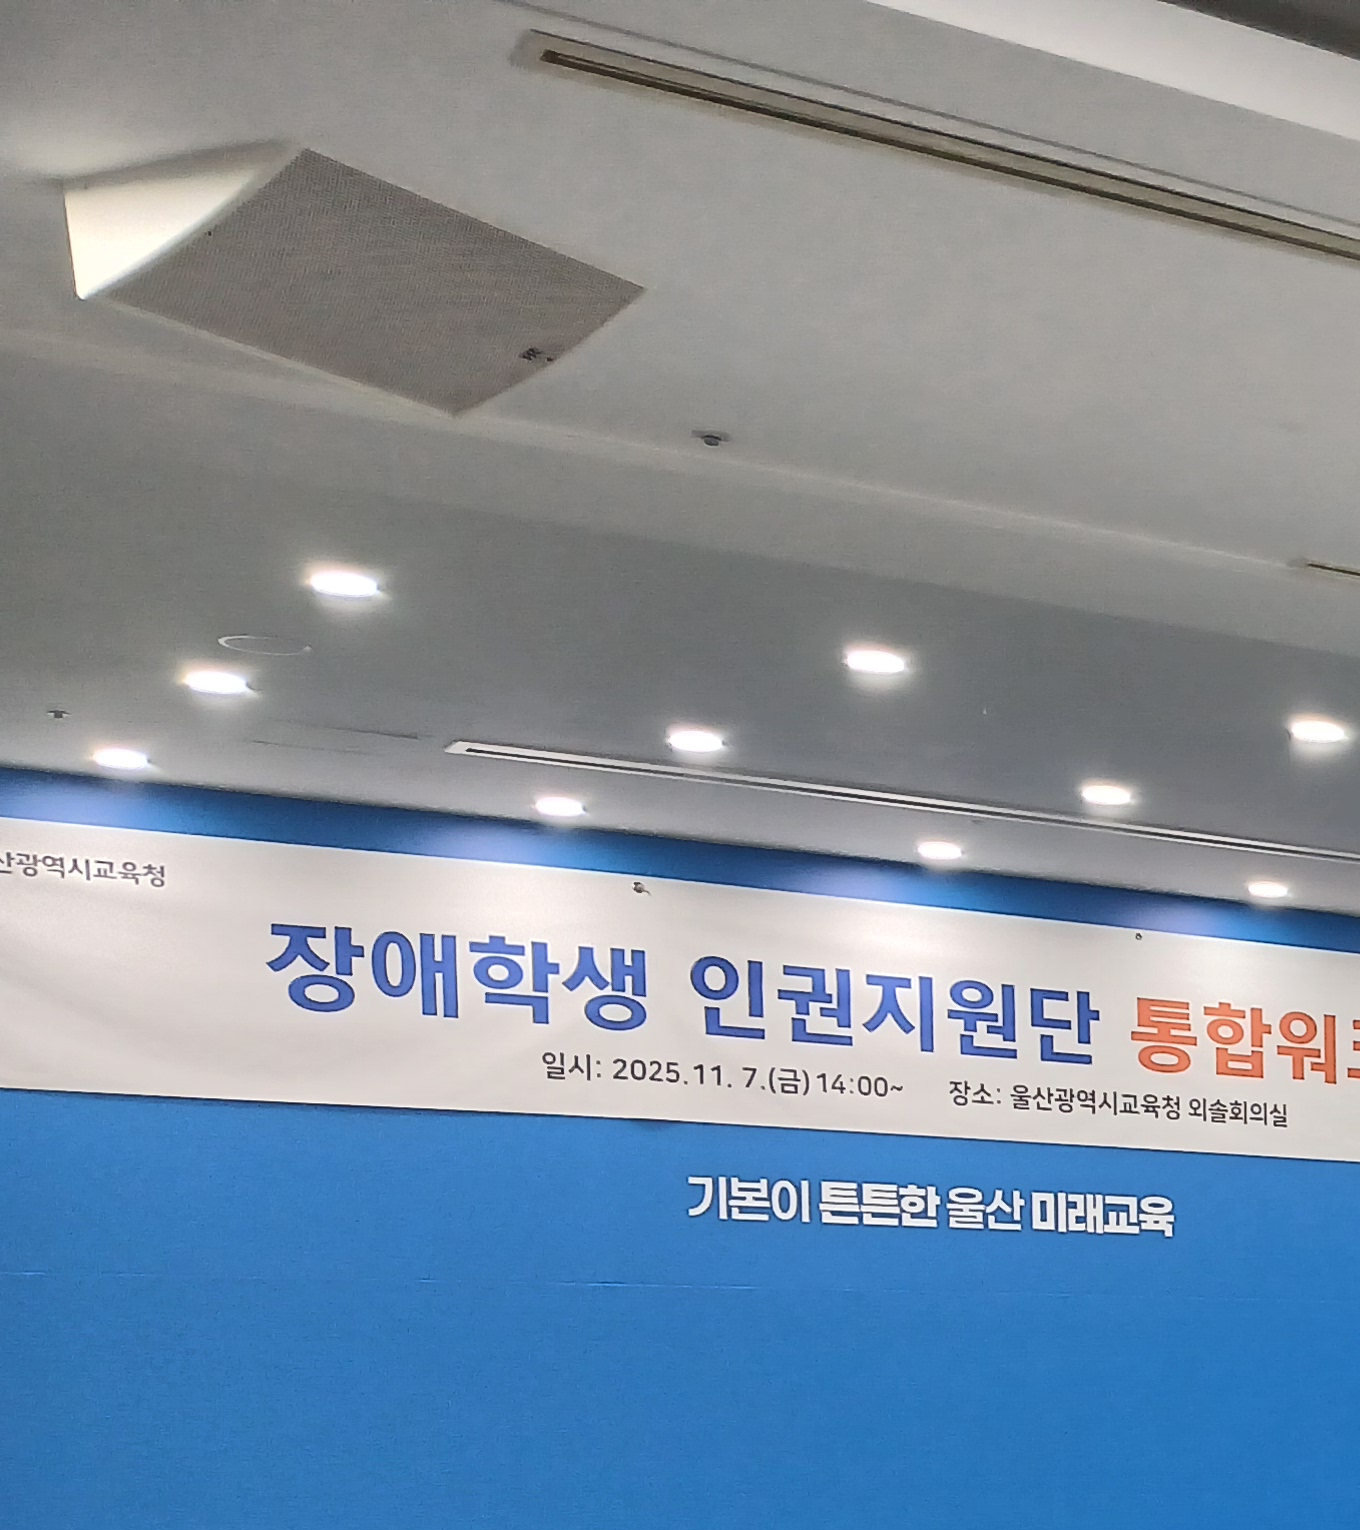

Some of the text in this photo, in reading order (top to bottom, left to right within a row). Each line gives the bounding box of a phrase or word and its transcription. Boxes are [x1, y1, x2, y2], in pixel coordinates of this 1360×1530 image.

[266, 922, 648, 1031] 장애학생
[690, 955, 1100, 1068] 인권지원단
[541, 1051, 602, 1081] 일시:
[949, 1080, 1289, 1128] 장소: 울산광역시교육청 외솔회의실
[686, 1174, 1176, 1238] 기본이 튼튼한 울산 미래교육
